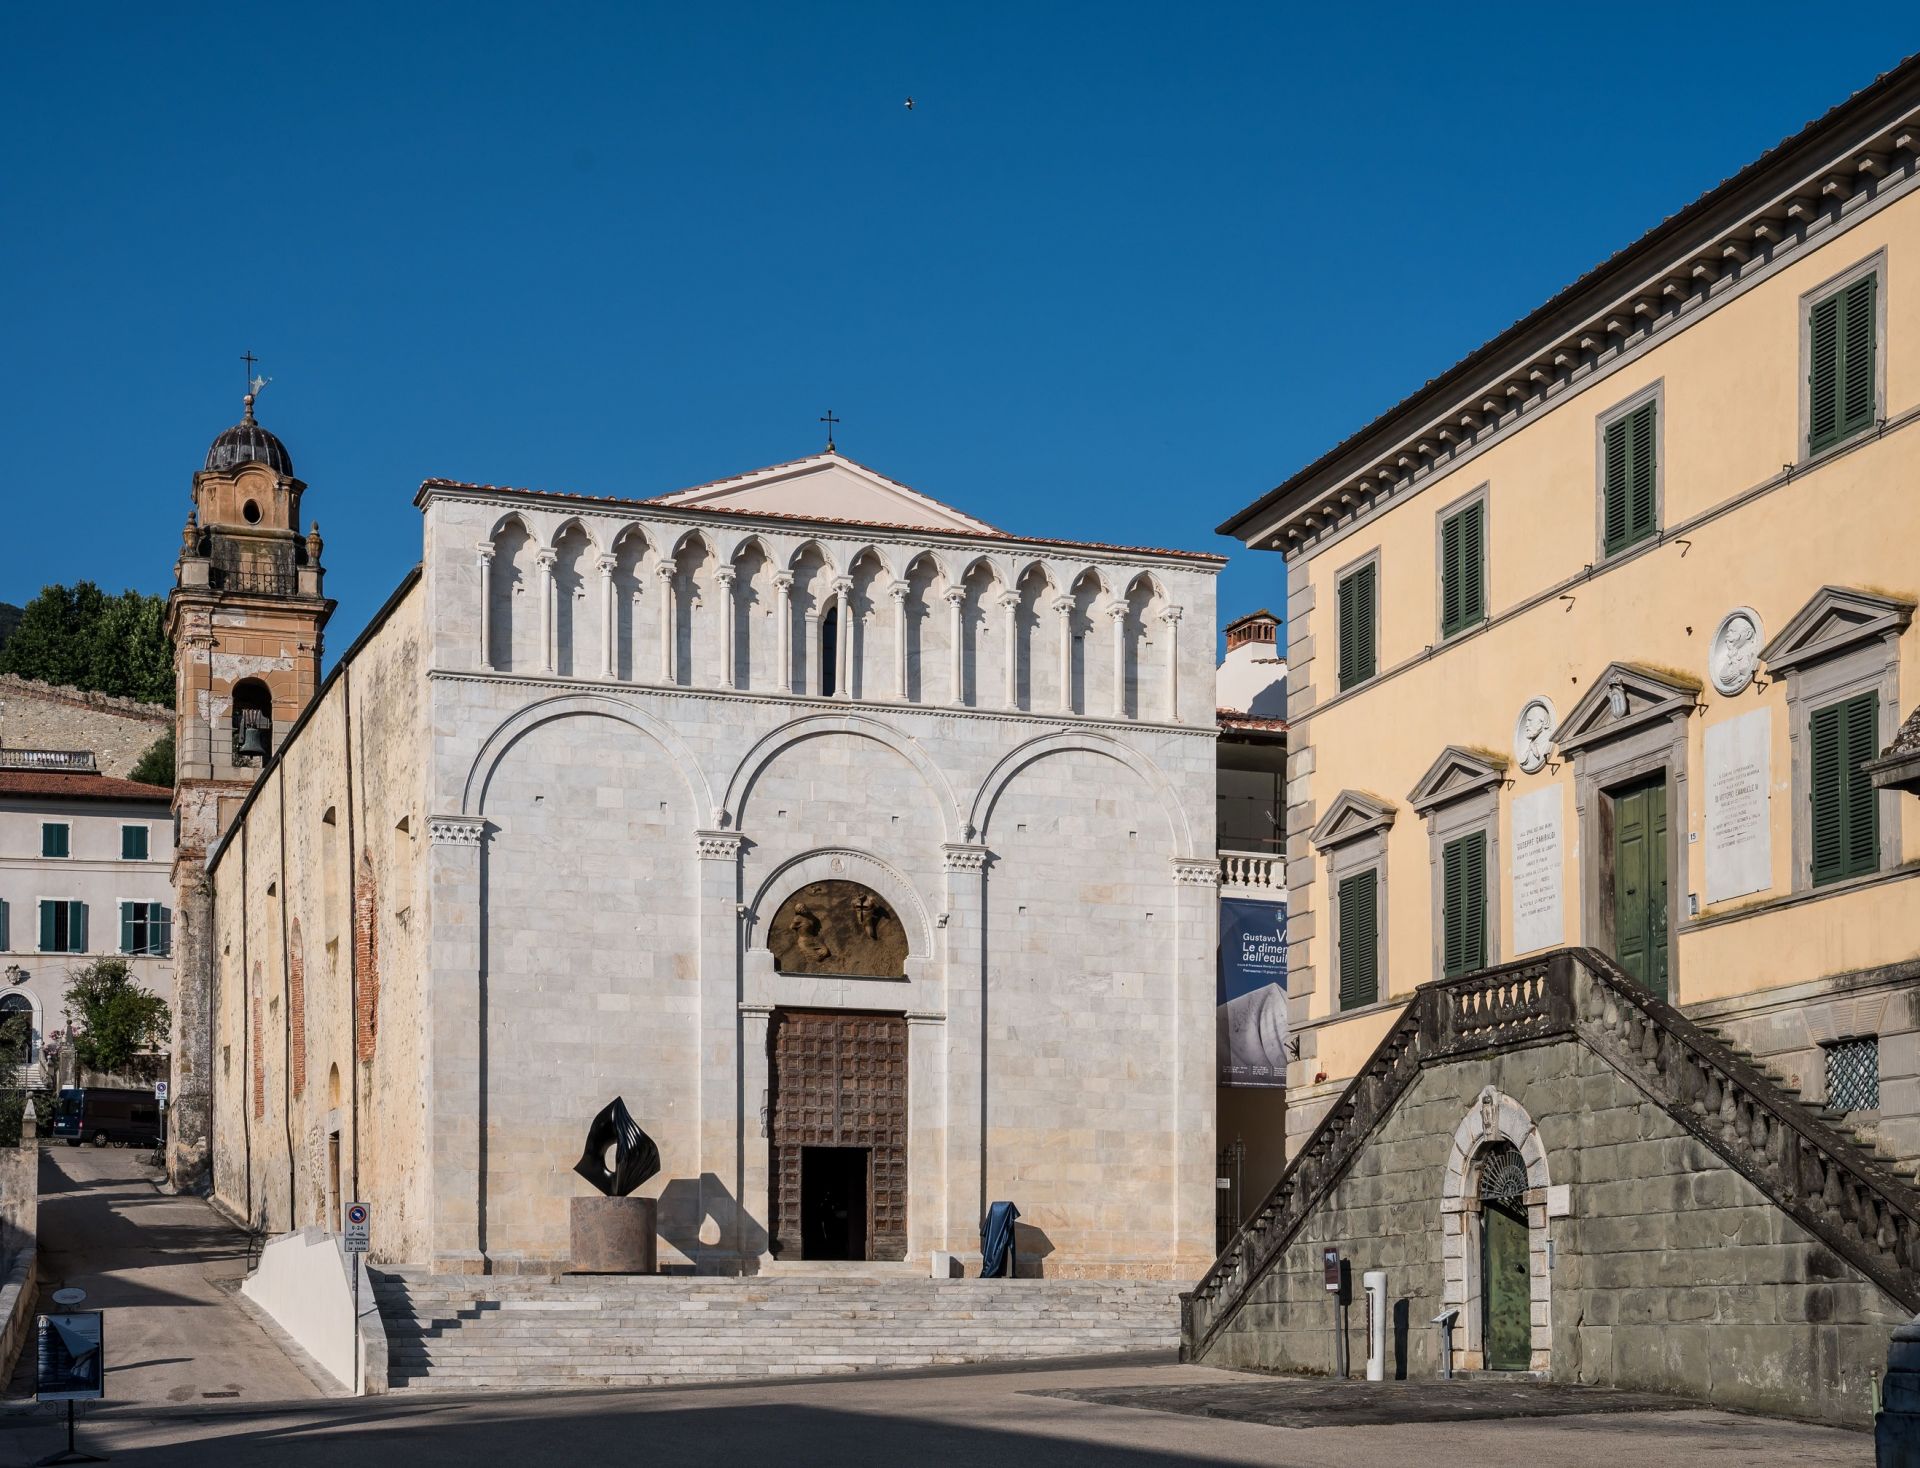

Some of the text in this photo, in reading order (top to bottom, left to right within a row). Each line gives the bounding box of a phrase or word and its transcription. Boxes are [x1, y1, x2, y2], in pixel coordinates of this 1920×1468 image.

[1536, 831, 1556, 844] GARIBALDI
[1242, 929, 1288, 943] Gustavo V
[1242, 941, 1255, 952] Le
